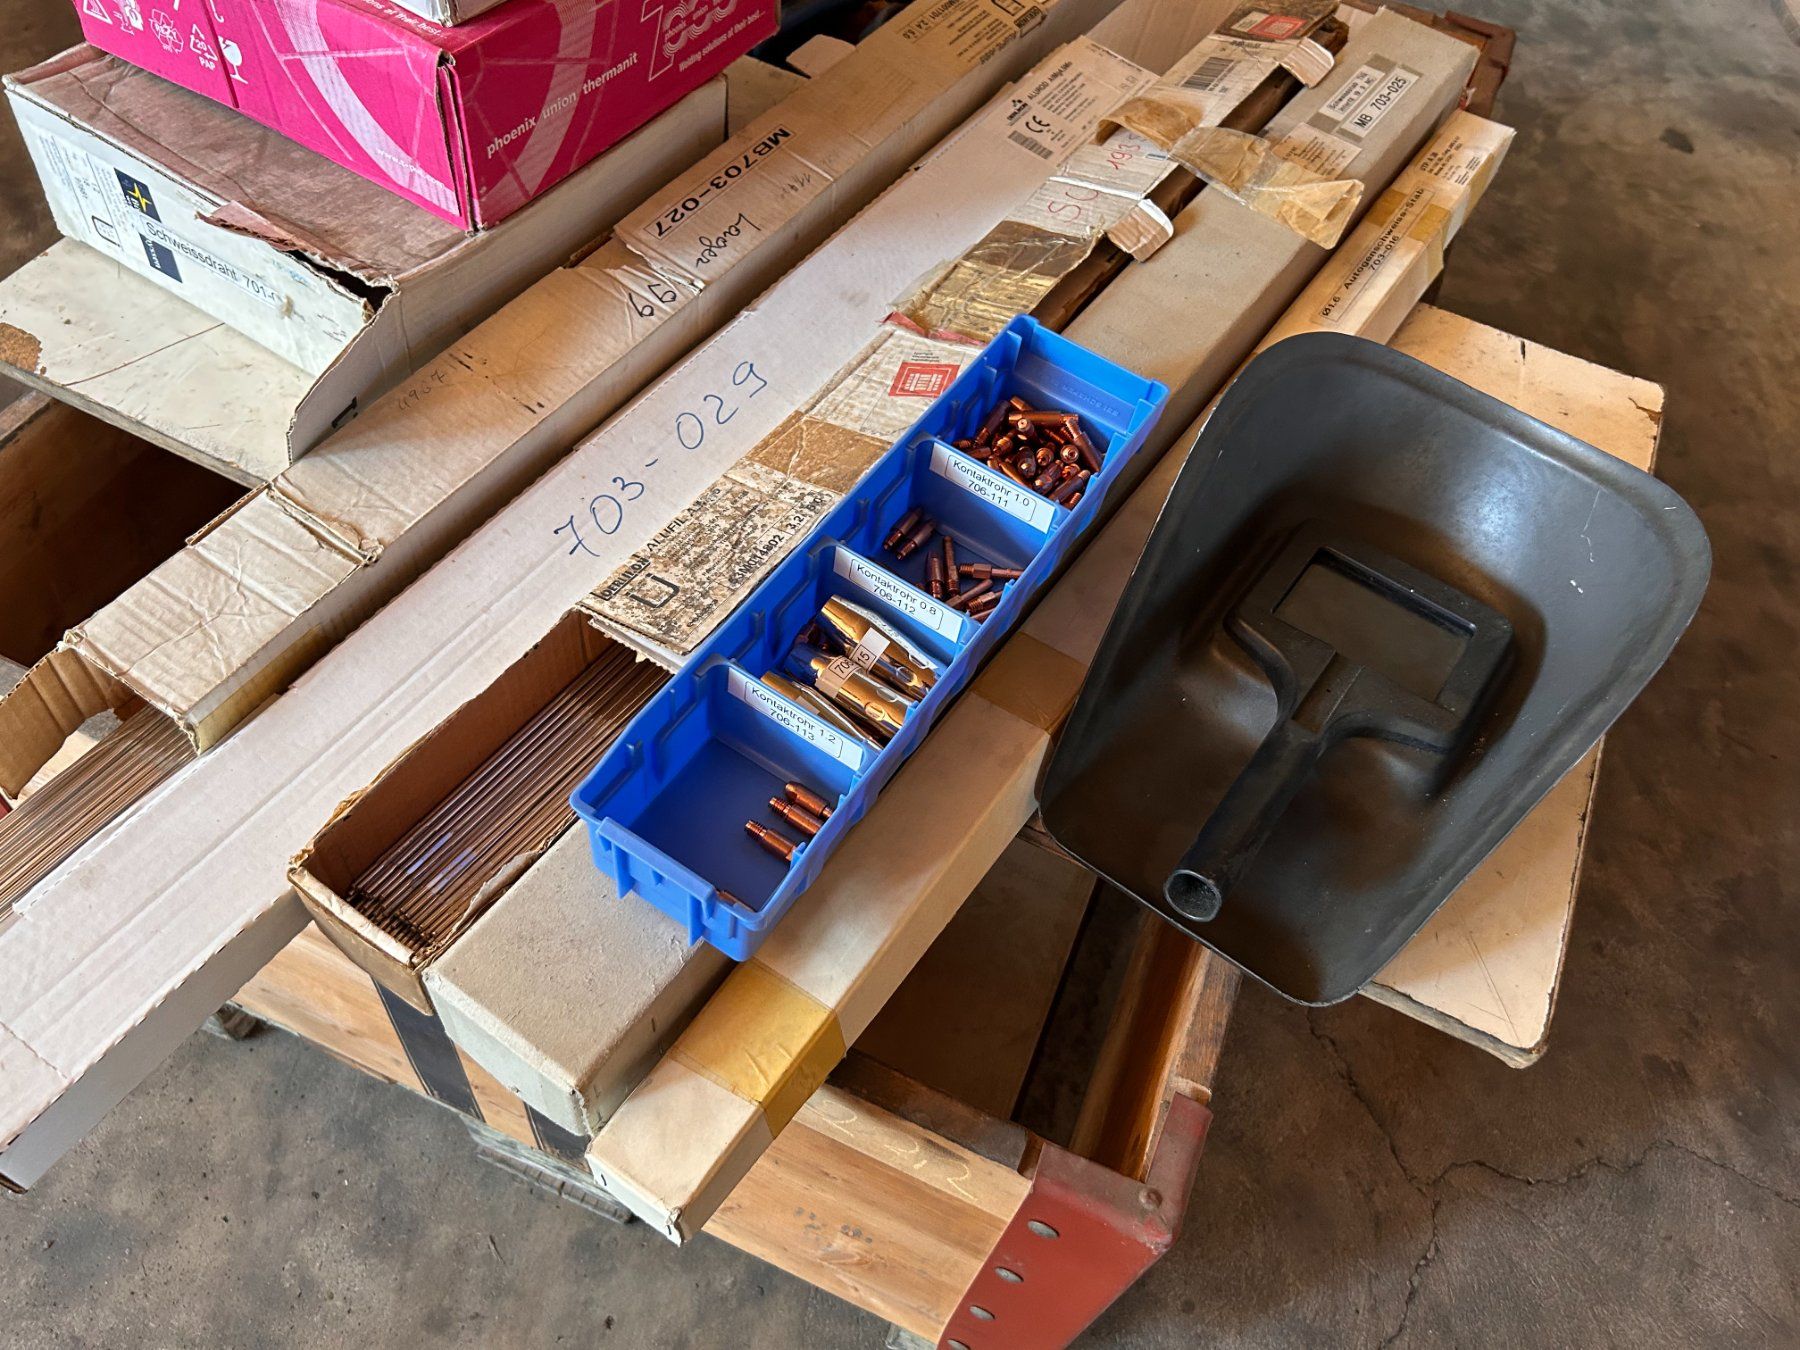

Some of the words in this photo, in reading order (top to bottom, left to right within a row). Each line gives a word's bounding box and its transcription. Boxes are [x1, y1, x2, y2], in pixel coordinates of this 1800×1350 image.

[485, 116, 537, 160] phoenix
[542, 91, 577, 119] union
[582, 52, 639, 96] thermanit
[1353, 112, 1374, 129] MB
[1369, 76, 1407, 111] 703-025
[652, 127, 791, 238] MB703-027
[147, 223, 240, 281] Schweissdraht
[1343, 187, 1425, 290] Autogenschweiss-Stab
[1368, 234, 1401, 272] 703-016
[952, 459, 1012, 497] Kontaktrohr
[968, 479, 1008, 507] 706-111
[857, 563, 918, 604] Kontaktrohr
[873, 584, 916, 615] 706-112
[751, 686, 816, 730] Kontaktrohr
[769, 708, 815, 741] 706-113
